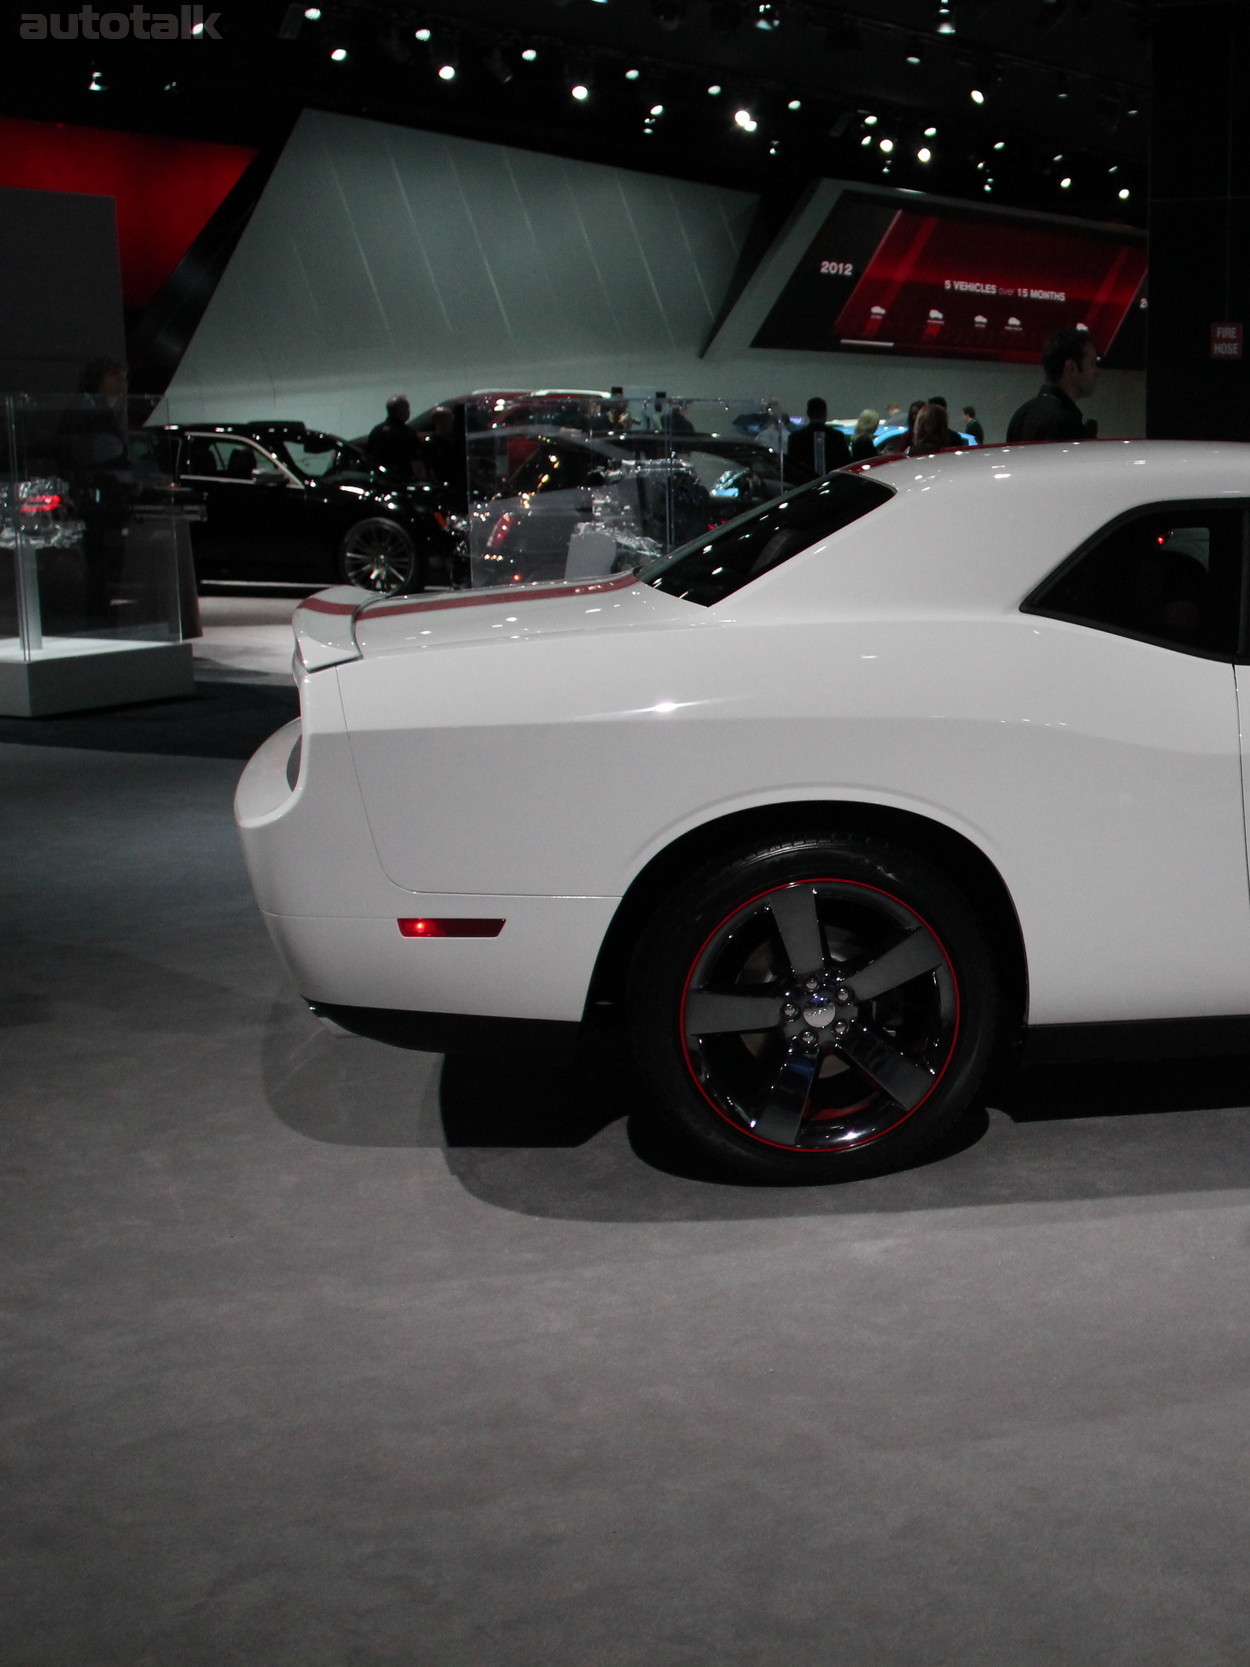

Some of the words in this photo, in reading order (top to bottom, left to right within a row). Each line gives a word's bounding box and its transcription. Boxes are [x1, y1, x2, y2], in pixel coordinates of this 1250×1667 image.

[820, 260, 853, 275] 2012
[944, 280, 951, 290] 5
[953, 280, 997, 295] VEHICLES
[1017, 288, 1028, 297] 15
[1030, 289, 1066, 301] MONTHS
[1139, 298, 1148, 308] 2
[1216, 327, 1237, 338] FIRE
[1214, 343, 1239, 354] HOSE
